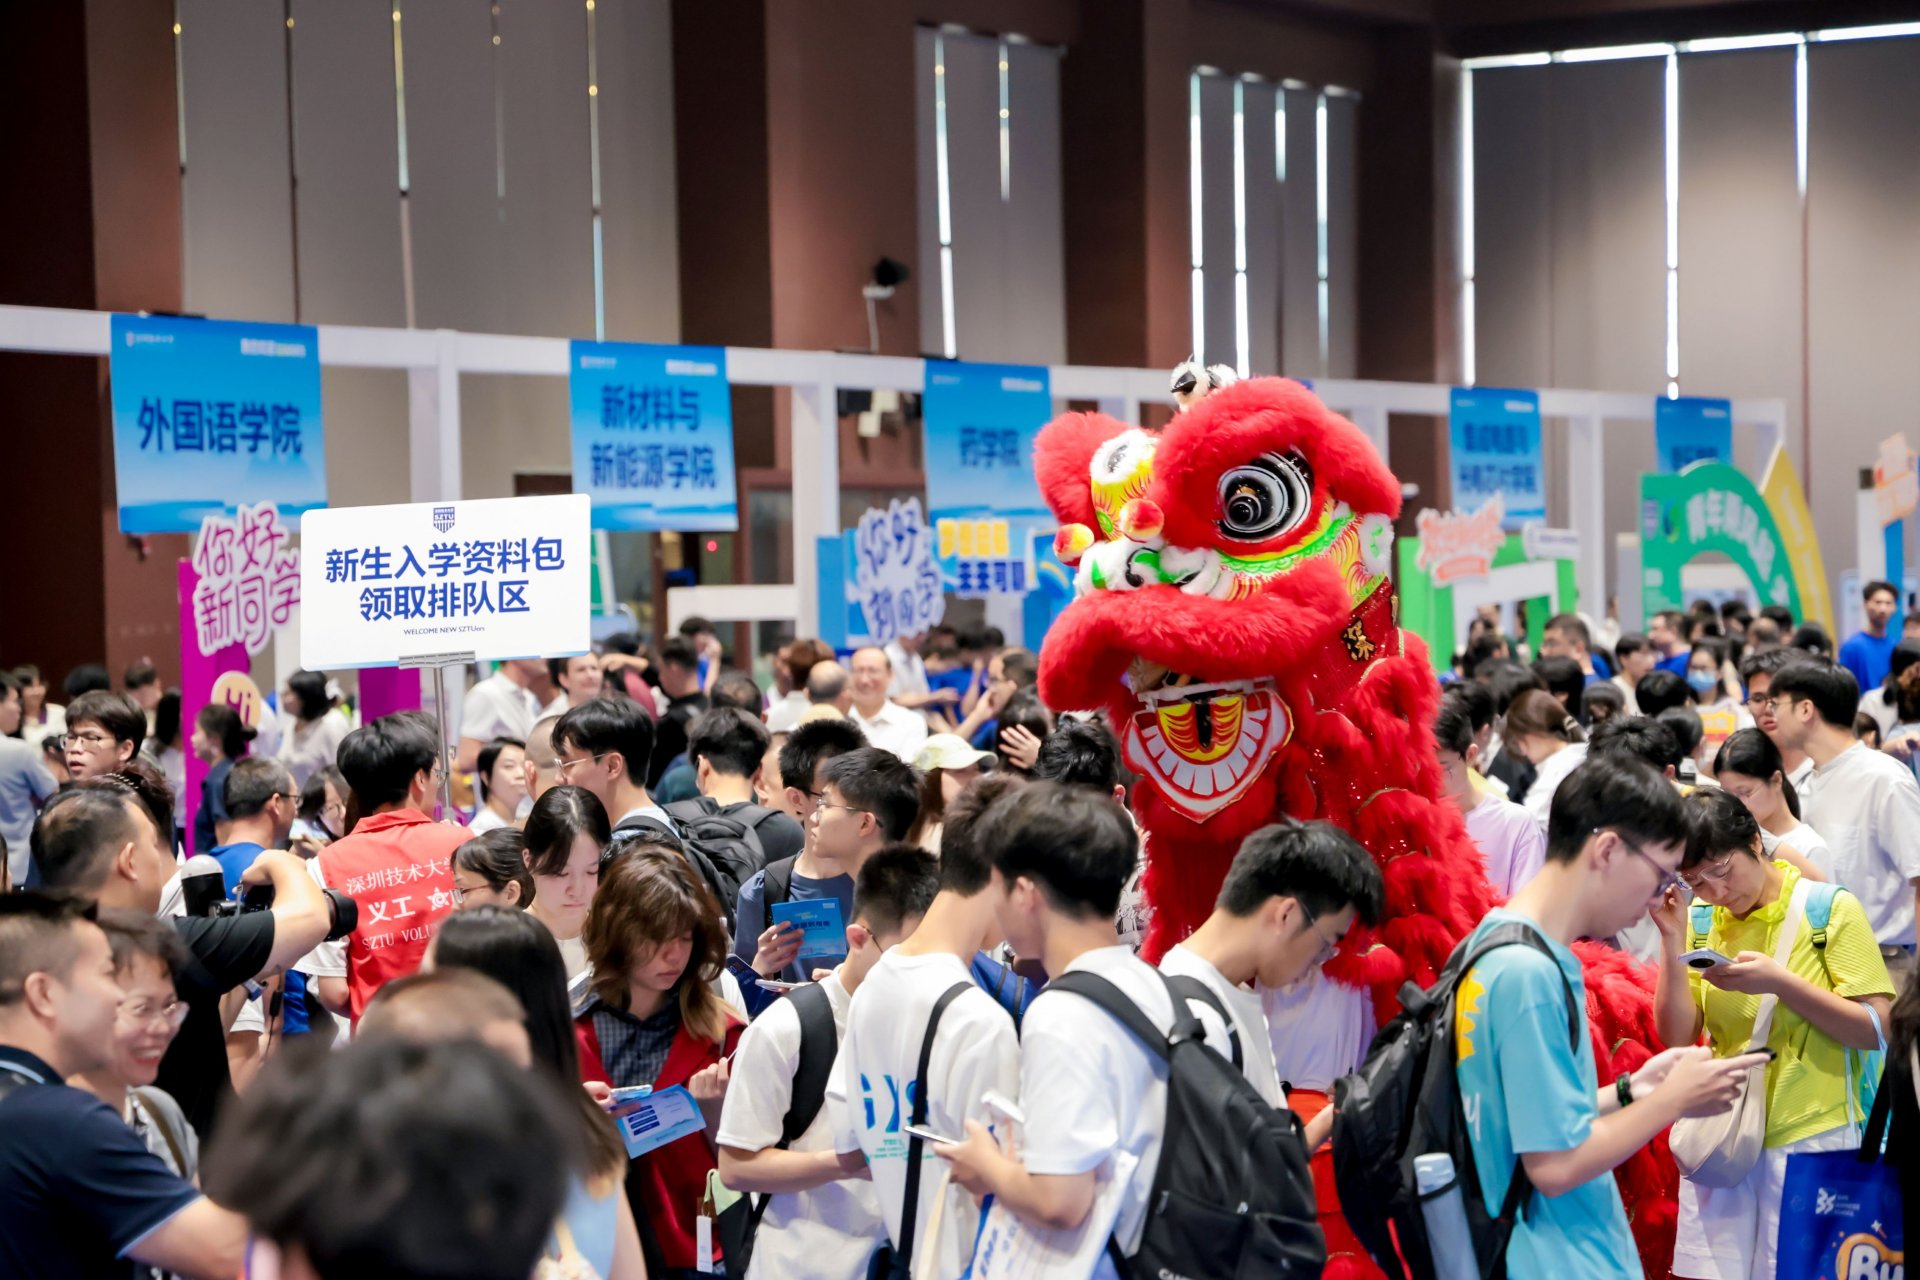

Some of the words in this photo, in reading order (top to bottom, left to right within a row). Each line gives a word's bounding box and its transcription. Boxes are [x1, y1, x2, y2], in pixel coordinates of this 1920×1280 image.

[138, 397, 302, 453] 外国语学院
[602, 384, 699, 432] 新材料与
[591, 441, 717, 490] 新能源学院
[199, 510, 284, 577] 你好
[325, 536, 565, 583] 新生入学资料包
[200, 556, 301, 647] 新同学
[359, 580, 531, 622] 领取排队区
[403, 627, 439, 635] WELCOME
[367, 895, 416, 926] 义工
[362, 932, 395, 951] SZTU
[401, 924, 438, 943] VOLU
